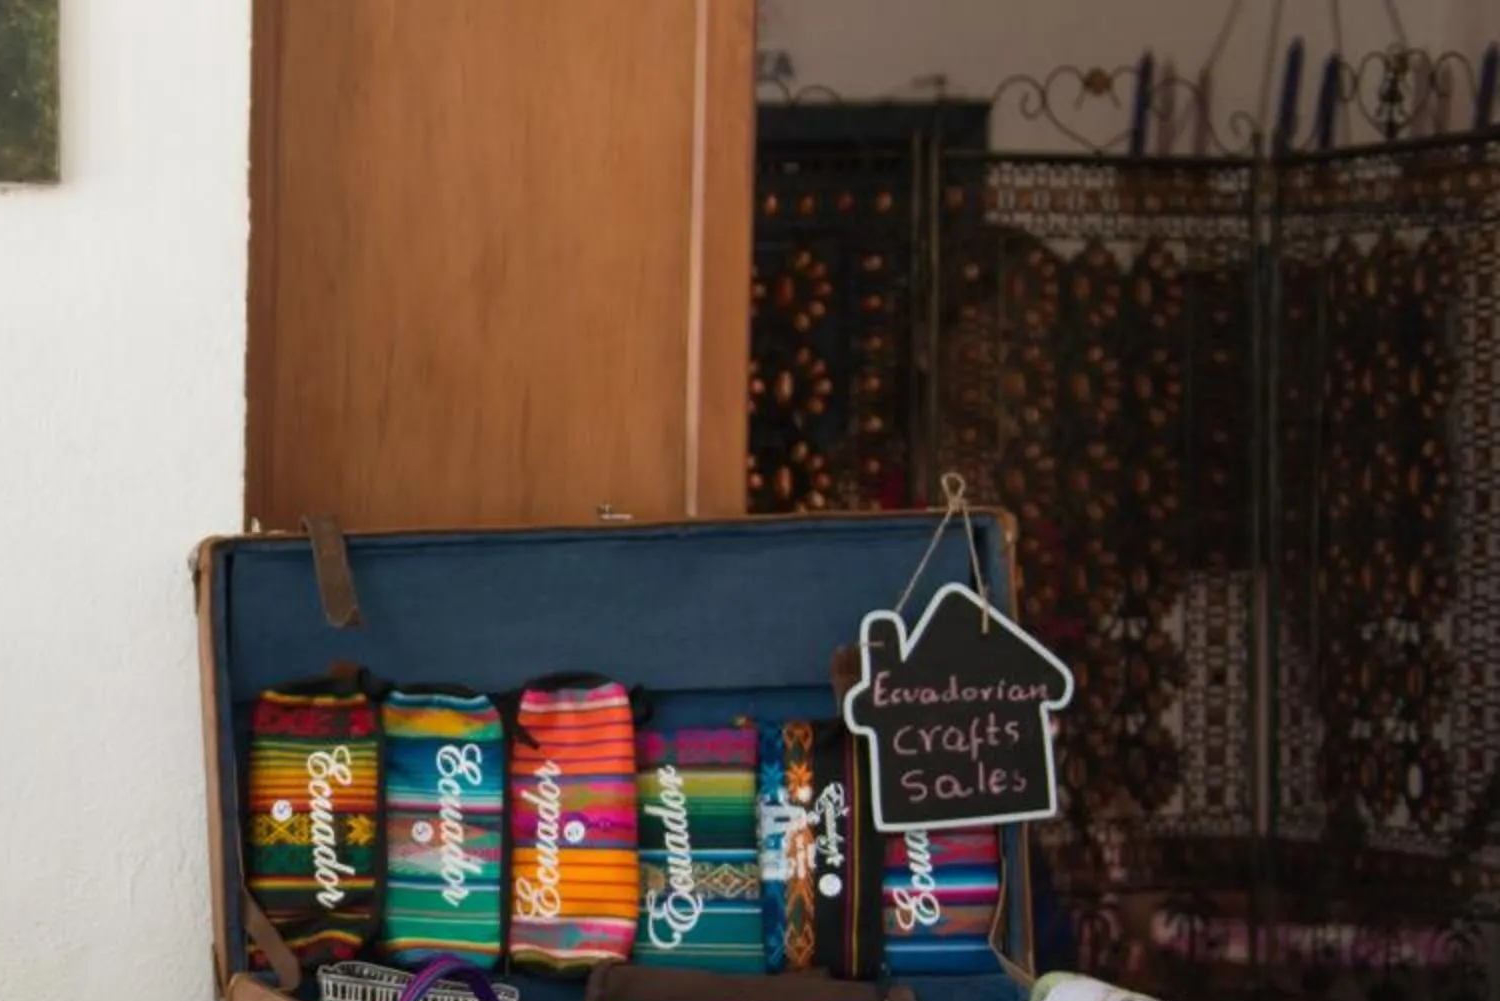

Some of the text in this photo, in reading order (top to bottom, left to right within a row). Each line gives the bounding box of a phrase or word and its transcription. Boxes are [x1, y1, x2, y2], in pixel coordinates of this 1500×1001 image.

[306, 745, 355, 908] Ecuador
[436, 743, 483, 907] Ecuador
[515, 760, 562, 919] Ecuador
[644, 764, 703, 949] Ecuador
